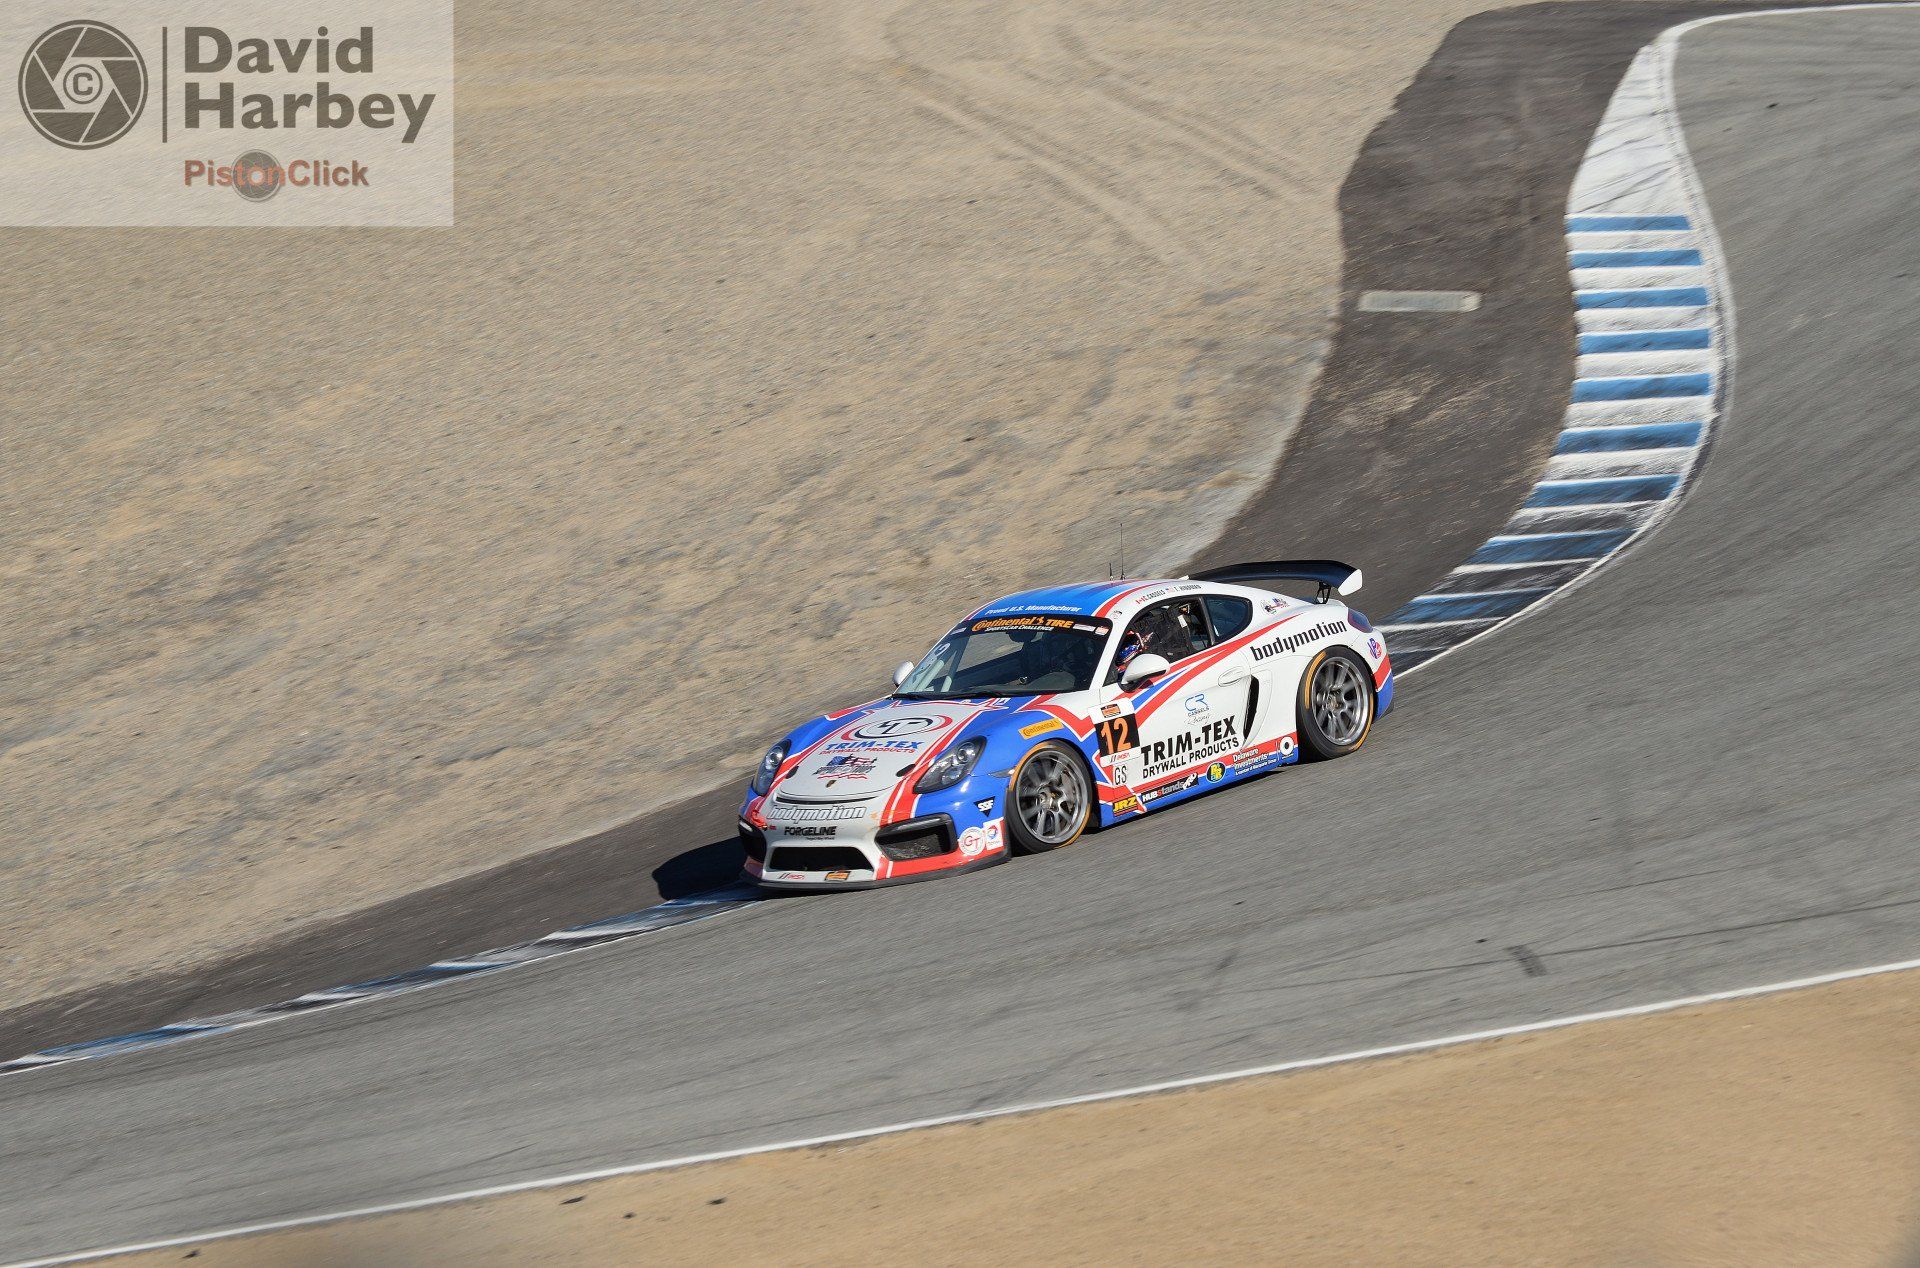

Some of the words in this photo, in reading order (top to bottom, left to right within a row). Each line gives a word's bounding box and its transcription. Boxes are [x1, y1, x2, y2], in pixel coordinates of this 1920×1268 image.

[985, 606, 1009, 615] Proud
[1025, 604, 1082, 613] Manufacturer
[1047, 618, 1074, 629] TIRE
[1250, 620, 1348, 661] bodymotion
[1101, 717, 1132, 755] 12
[1141, 715, 1237, 766] TRIM-TEX
[820, 747, 861, 755] DRYWALL
[825, 741, 924, 751] TRIM-TEX
[1142, 760, 1187, 779] DRYWALL
[1189, 737, 1240, 763] PRODUCTS
[1114, 765, 1127, 785] GS
[766, 805, 867, 824] bodymotion
[784, 826, 837, 837] FORGELINE
